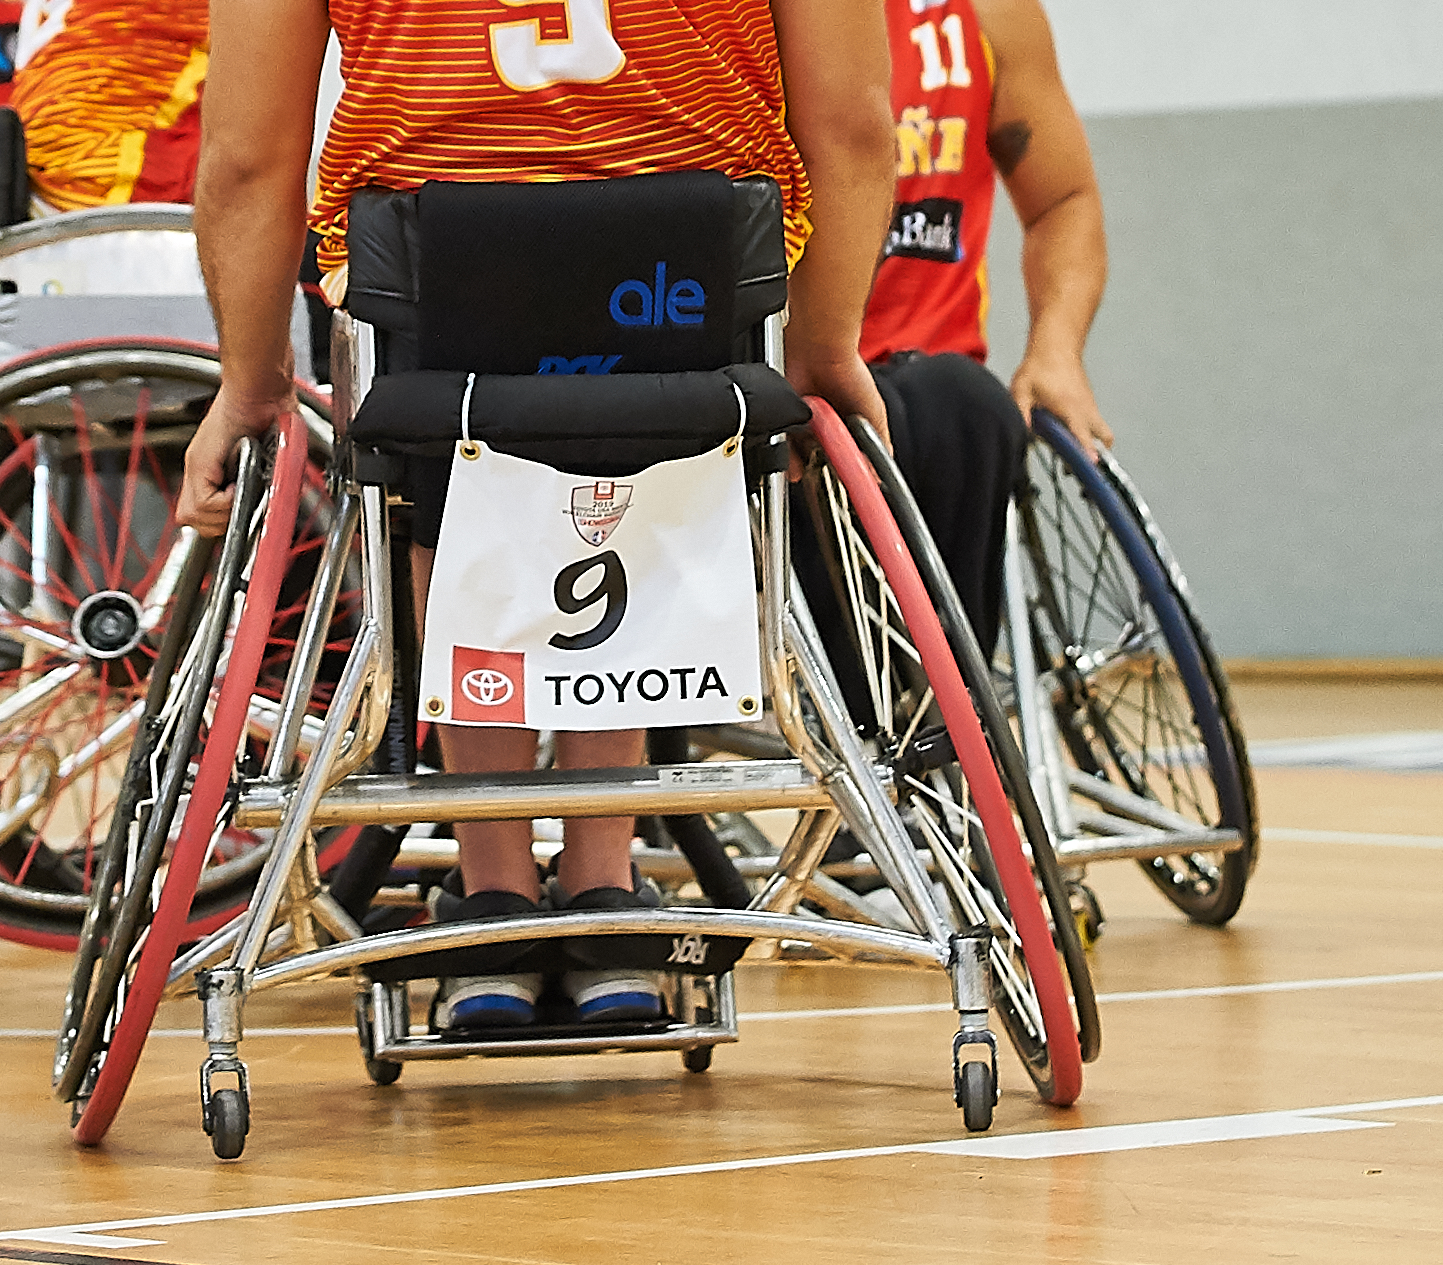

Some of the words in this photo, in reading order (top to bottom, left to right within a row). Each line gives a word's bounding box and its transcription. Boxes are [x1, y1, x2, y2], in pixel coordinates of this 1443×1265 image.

[910, 13, 972, 92] 11
[609, 261, 706, 326] ale
[547, 550, 629, 651] 9
[544, 666, 729, 706] TOYOTA
